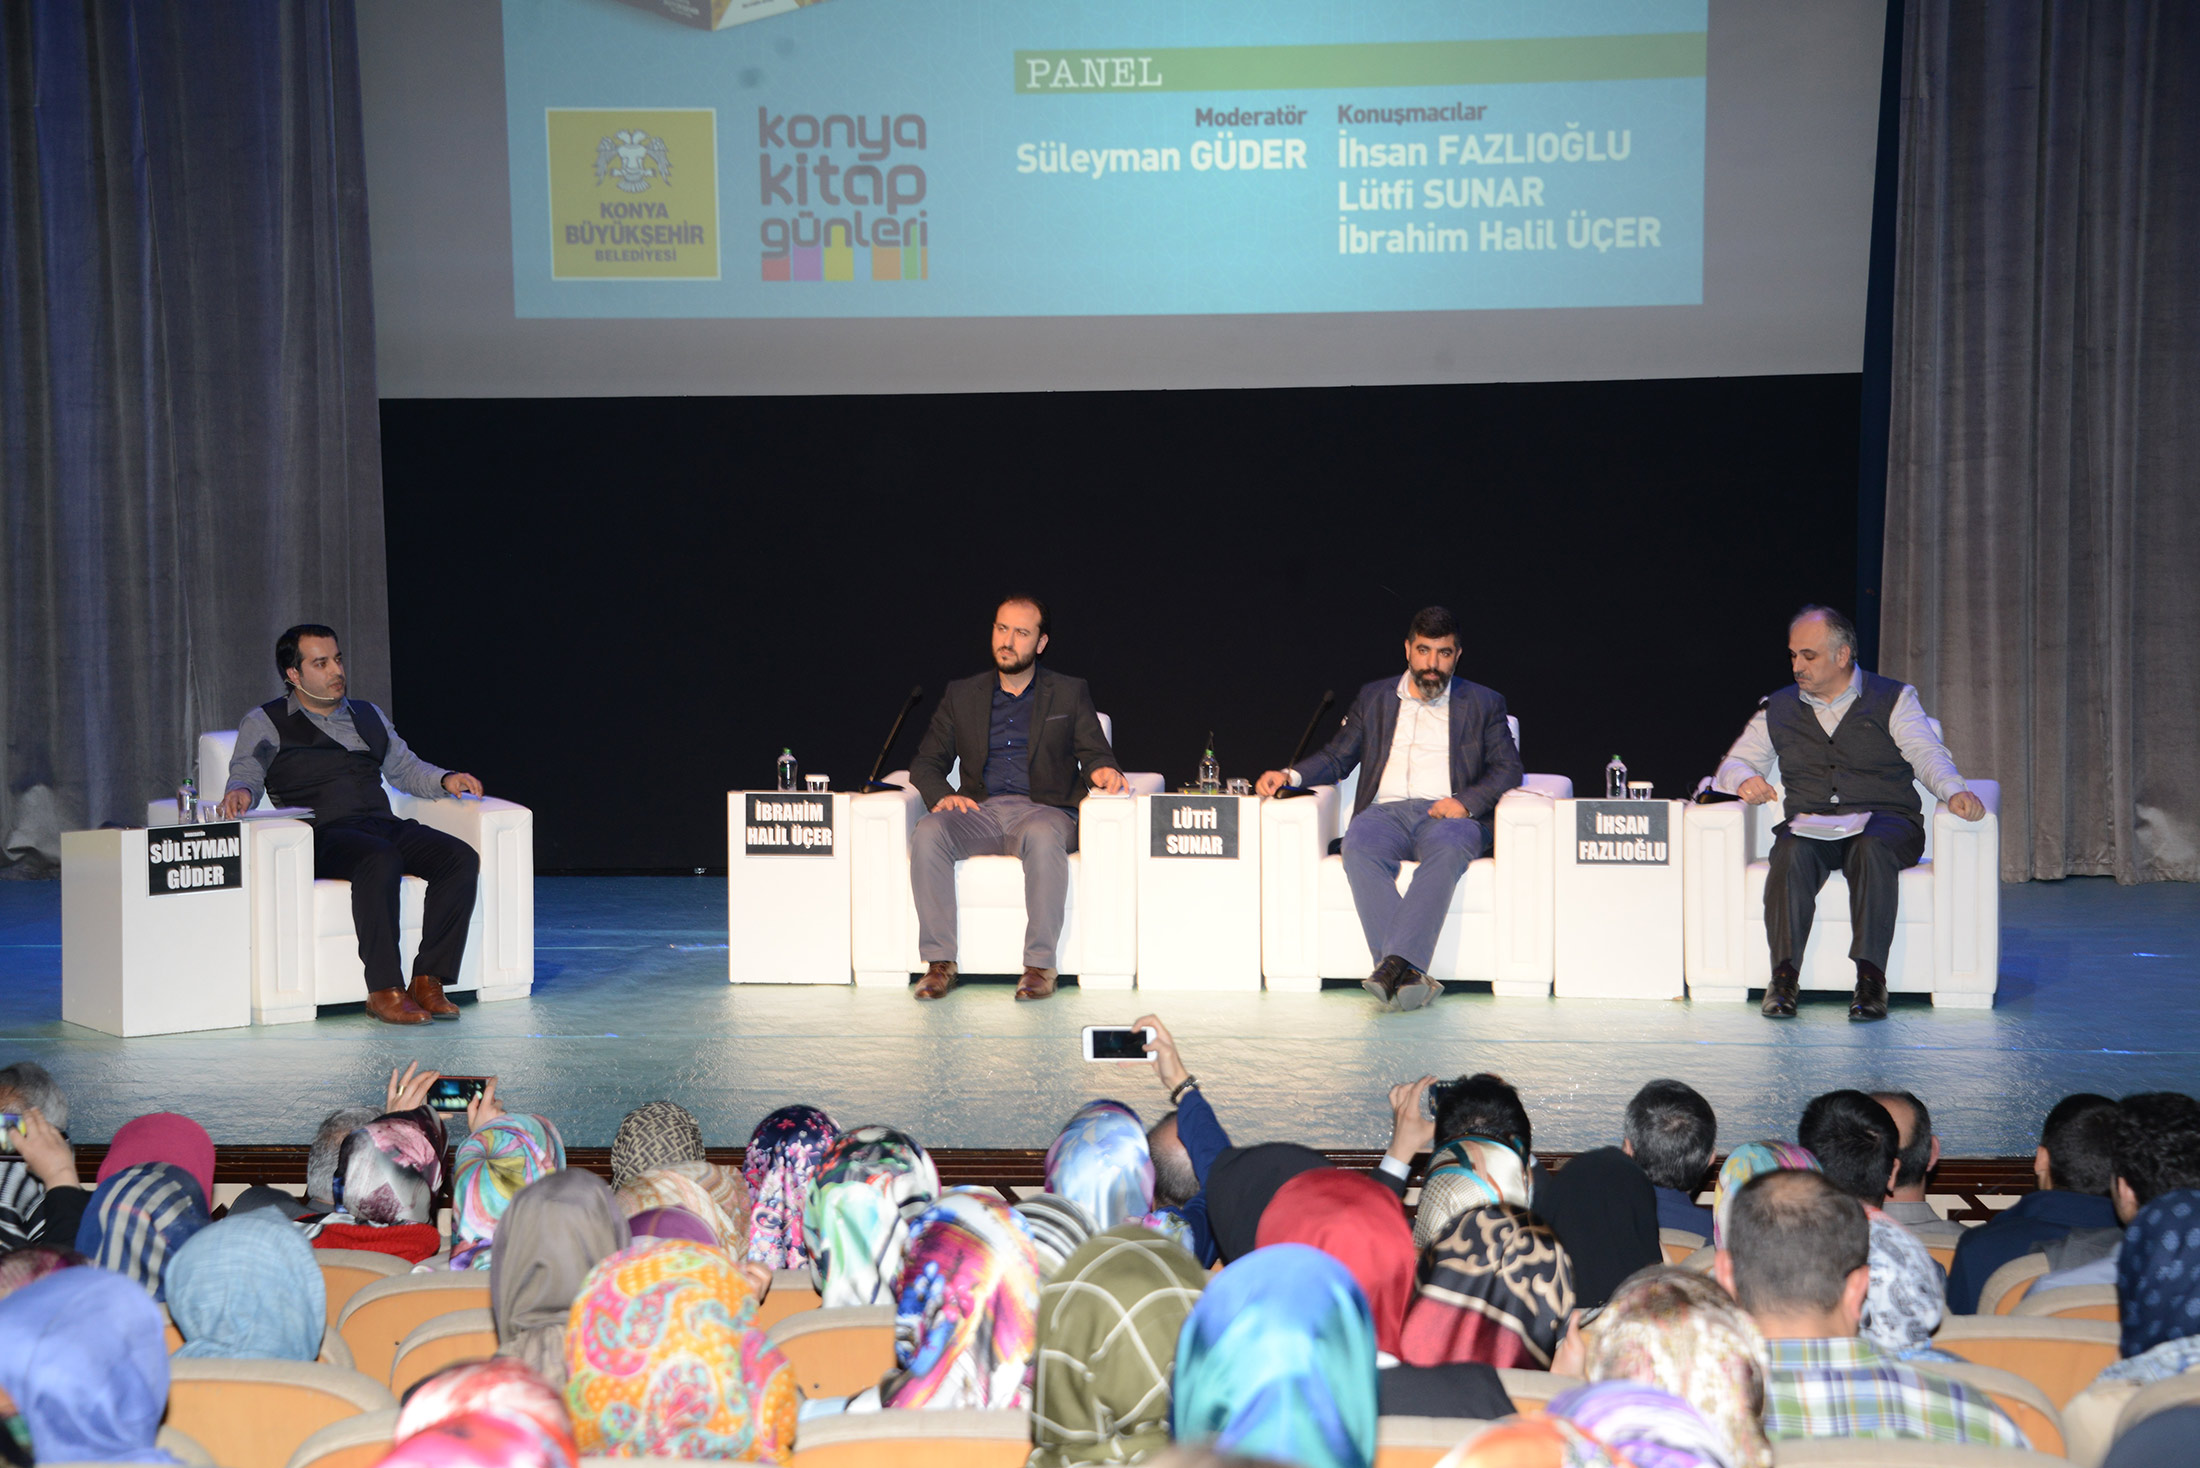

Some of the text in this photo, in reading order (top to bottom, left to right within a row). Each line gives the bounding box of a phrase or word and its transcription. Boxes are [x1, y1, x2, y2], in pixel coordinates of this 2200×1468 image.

[1025, 57, 1162, 88] PANEL
[1195, 105, 1308, 127] Moderatör
[1338, 101, 1488, 125] Konuşmacılar
[758, 106, 927, 162] konya
[1339, 122, 1631, 168] İhsan FAZLIOĞLU
[1016, 131, 1308, 179] Süleyman GÜDER
[760, 153, 927, 214] kitap
[1339, 177, 1545, 211] Lütfi SUNAR
[600, 202, 669, 220] KONYA
[565, 220, 704, 248] BÜYÜKŞEHİR
[760, 211, 928, 259] günleri
[1339, 210, 1662, 254] İbrahim Halil ÜÇER
[595, 247, 677, 262] BELEDİYESİ
[755, 799, 824, 822] İBRAHİM
[1172, 806, 1217, 829] LÜTFİ
[1596, 812, 1649, 835] İHSAN
[747, 824, 832, 849] HALİL ÜÇER
[1166, 834, 1223, 855] SUNAR
[150, 837, 240, 864] SÜLEYMAN
[1578, 838, 1667, 861] FAZLIOĞLU
[167, 864, 225, 889] GÜDER
